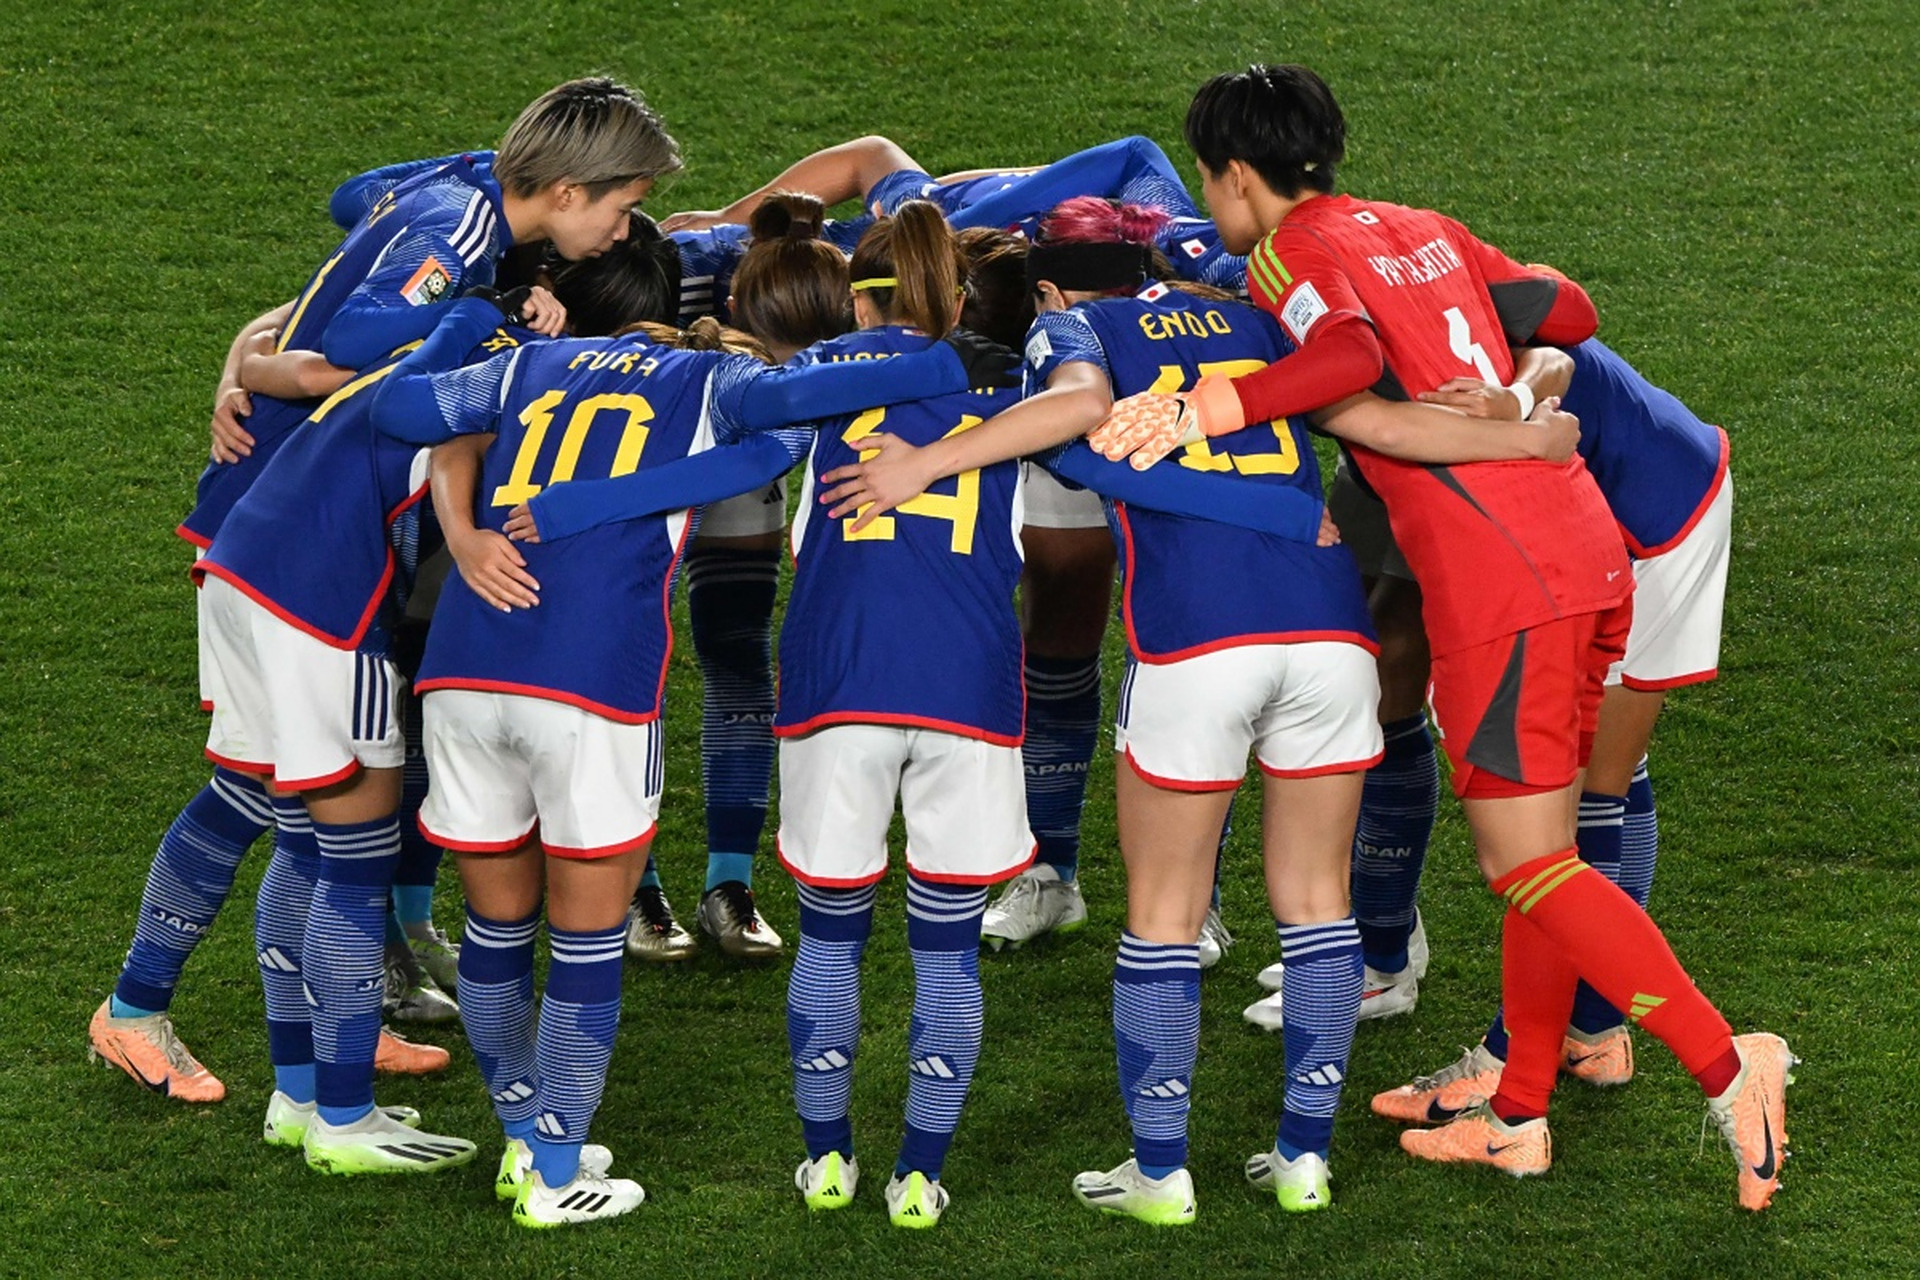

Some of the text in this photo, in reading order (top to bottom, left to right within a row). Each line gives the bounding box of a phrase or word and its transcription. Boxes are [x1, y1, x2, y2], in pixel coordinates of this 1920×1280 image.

[1139, 310, 1232, 340] ENDO
[567, 350, 659, 377] FUKA
[491, 390, 655, 507] 10
[841, 406, 984, 555] 14
